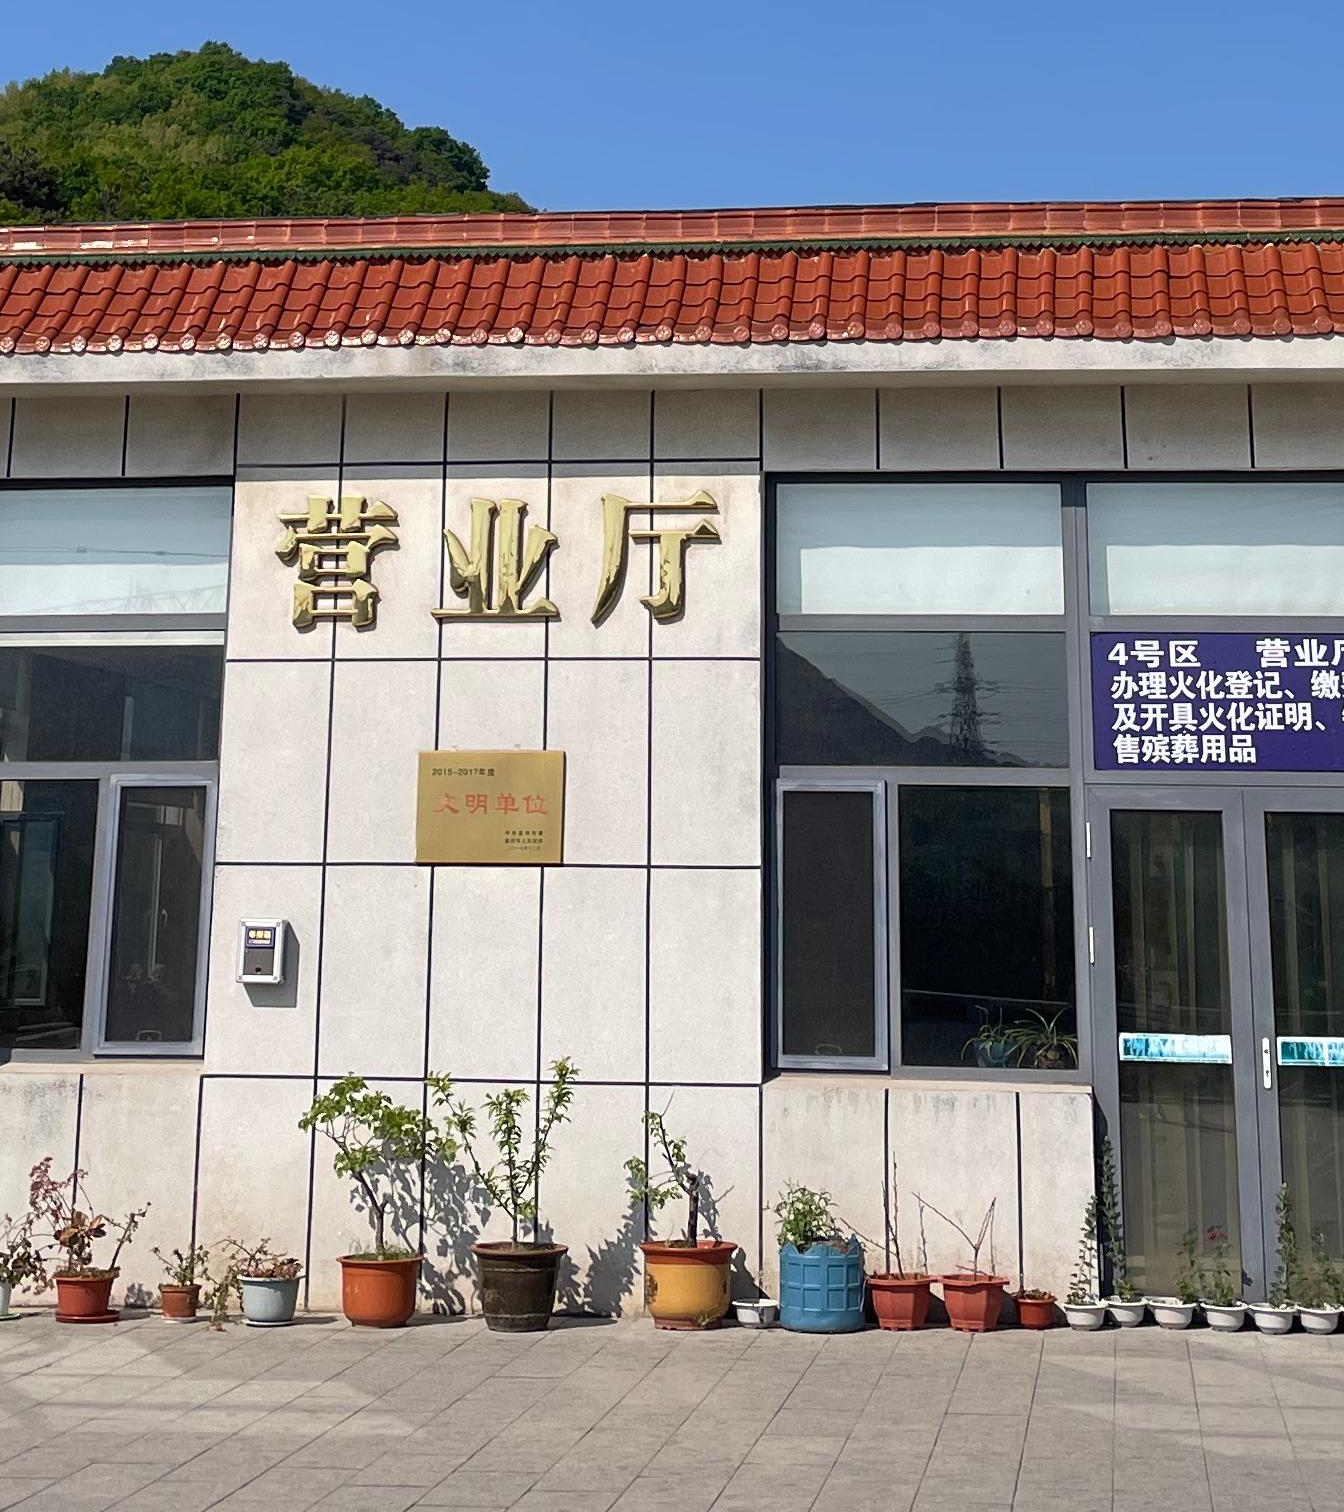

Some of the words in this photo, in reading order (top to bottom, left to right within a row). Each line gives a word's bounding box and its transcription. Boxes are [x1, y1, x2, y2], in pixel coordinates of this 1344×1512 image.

[274, 489, 722, 633] 营业厅
[1107, 639, 1202, 668] 4号区
[1112, 733, 1257, 764] 售殡葬用品
